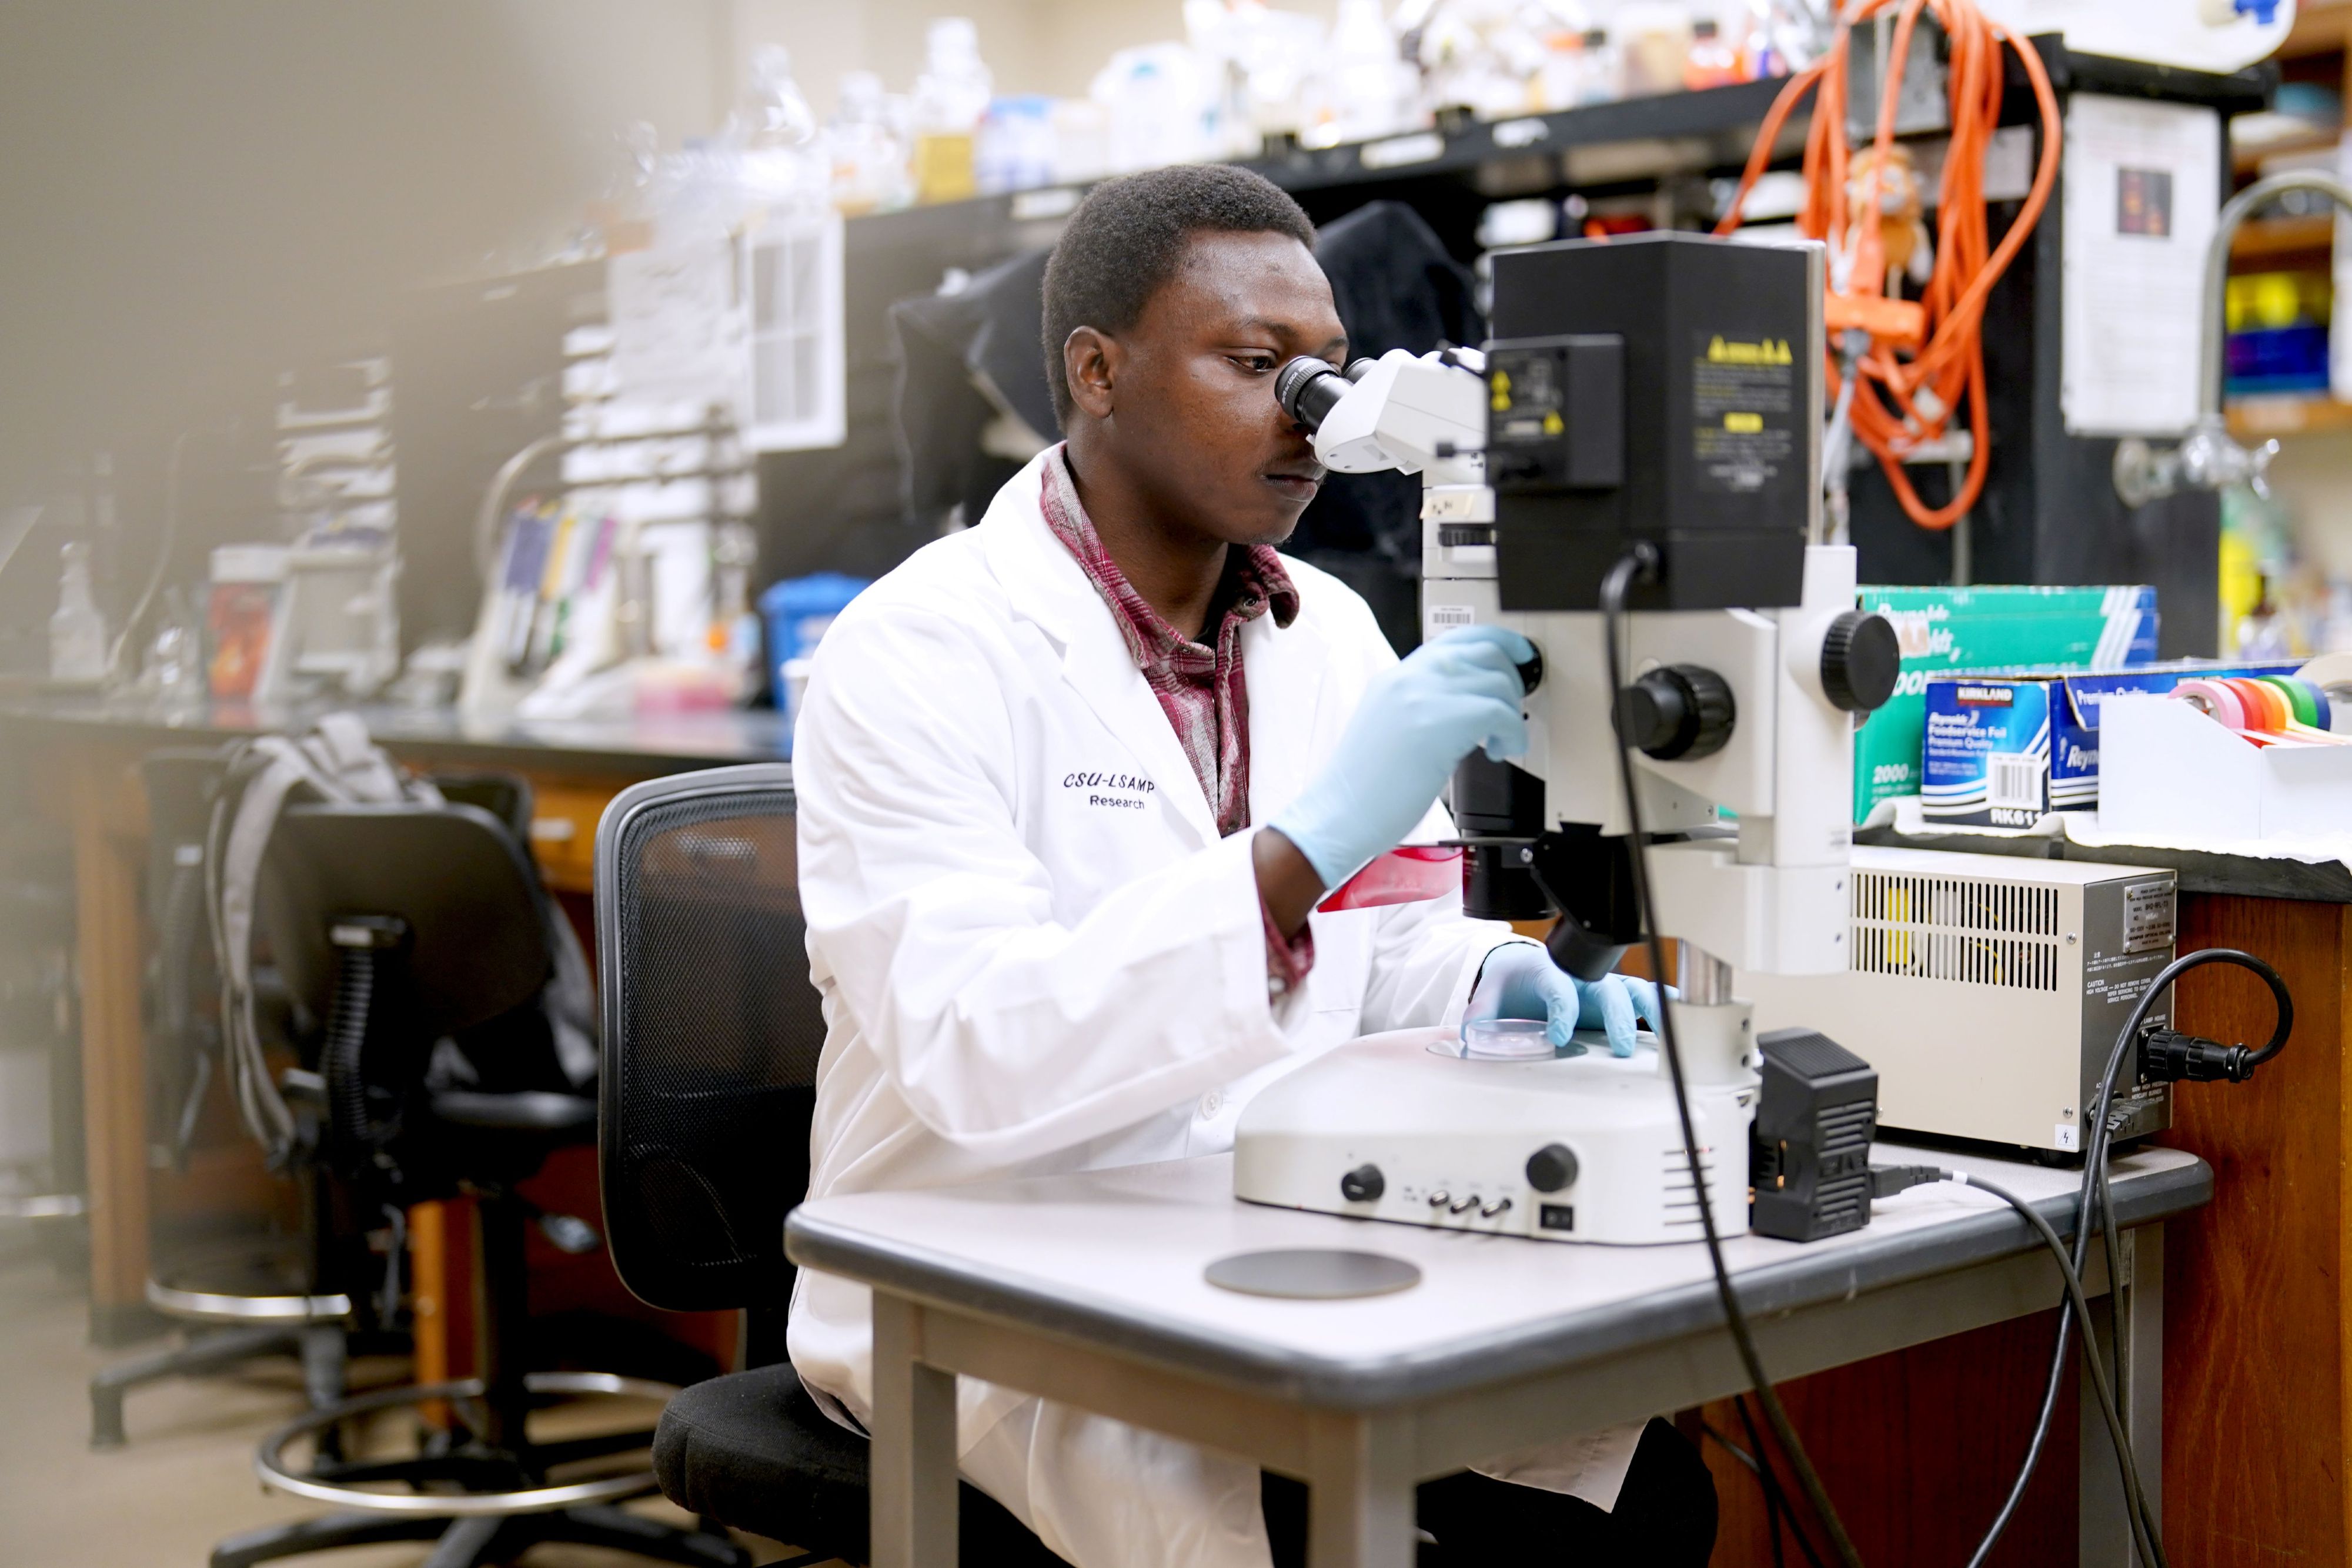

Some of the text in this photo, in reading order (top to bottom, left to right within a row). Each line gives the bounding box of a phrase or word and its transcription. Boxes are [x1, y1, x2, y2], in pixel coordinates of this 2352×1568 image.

[1957, 687, 2013, 701] KIRKLAND
[1988, 726, 2007, 738] Foil
[1872, 763, 1909, 784] 2000
[1063, 772, 1155, 794] CSU-LSAMP
[1090, 795, 1145, 810] Research
[2087, 979, 2104, 988] CAUTION
